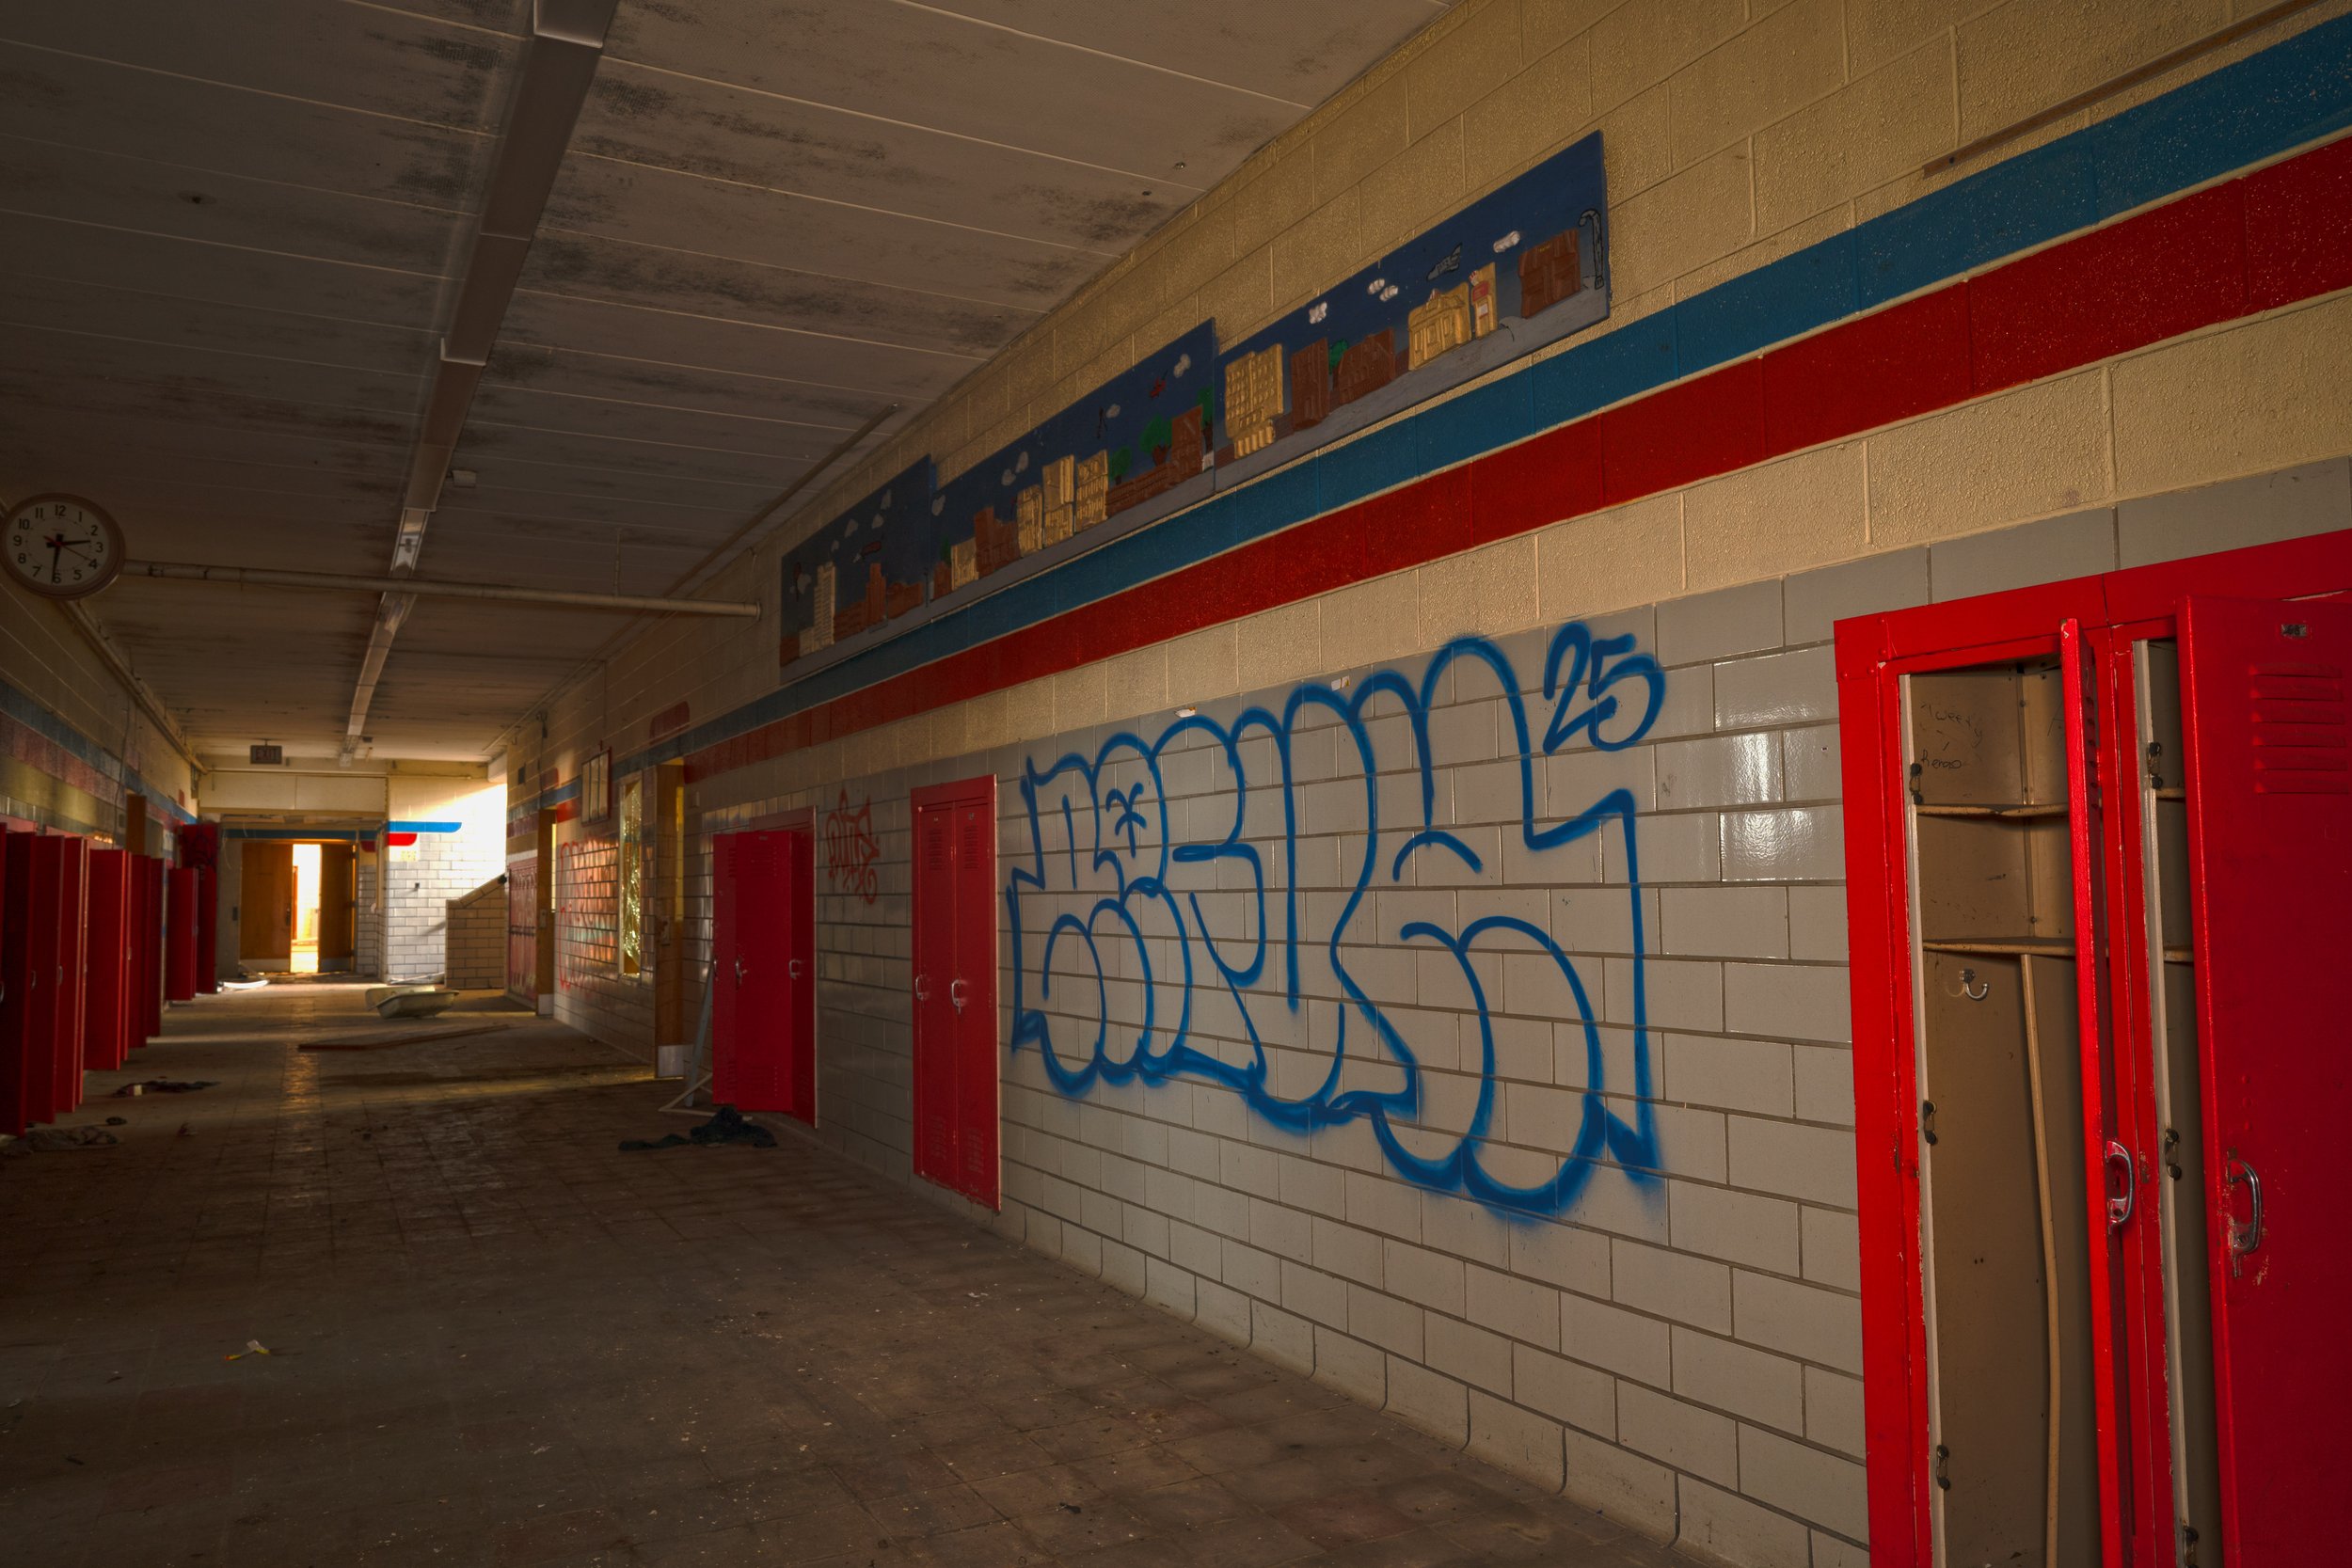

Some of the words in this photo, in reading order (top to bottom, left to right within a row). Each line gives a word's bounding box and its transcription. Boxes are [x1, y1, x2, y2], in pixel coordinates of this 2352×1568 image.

[35, 507, 43, 519] 11
[55, 504, 66, 516] 12
[78, 511, 82, 522] 1
[18, 518, 30, 530] 10
[90, 525, 98, 536] 2
[13, 535, 22, 546] 9
[95, 542, 103, 553] 3
[17, 553, 26, 563] 8
[88, 559, 98, 569] 4
[32, 565, 41, 577] 7
[73, 569, 82, 580] 5
[53, 572, 61, 583] 6
[1544, 622, 1664, 753] 25
[255, 748, 278, 761] EXIT
